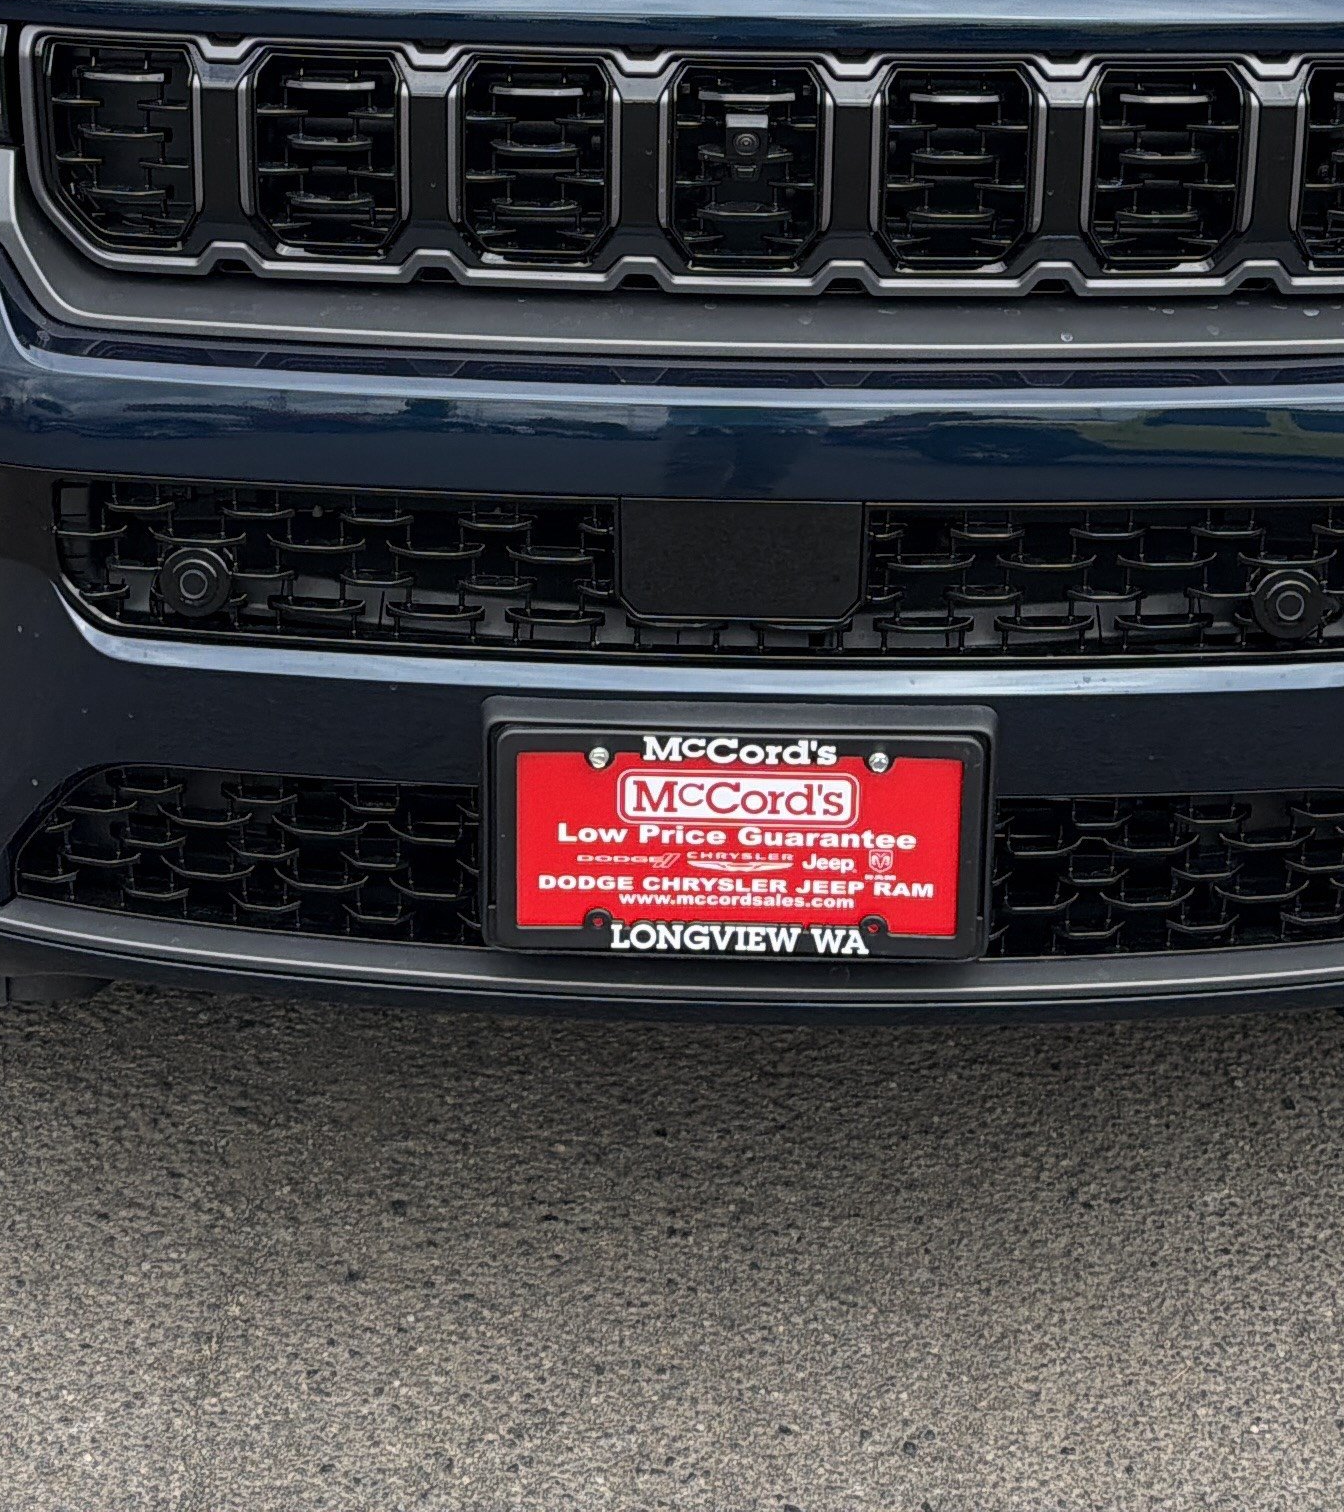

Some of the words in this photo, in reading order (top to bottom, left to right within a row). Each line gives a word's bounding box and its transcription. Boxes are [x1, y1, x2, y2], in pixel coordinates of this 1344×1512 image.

[643, 736, 837, 765] McCord's
[632, 779, 844, 816] McCord's
[558, 822, 628, 843] Low
[639, 824, 727, 844] Price
[737, 826, 917, 850] Guarantee
[686, 851, 794, 861] CHRYSLER
[801, 853, 856, 874] Jeep
[538, 874, 635, 892] DODGE
[642, 876, 788, 894] CHRYSLER
[795, 879, 865, 896] JEEP
[873, 881, 935, 899] RAM
[618, 893, 855, 909] www.mccordsales.com
[610, 923, 802, 953] LONGVIEW
[810, 927, 870, 955] WA
